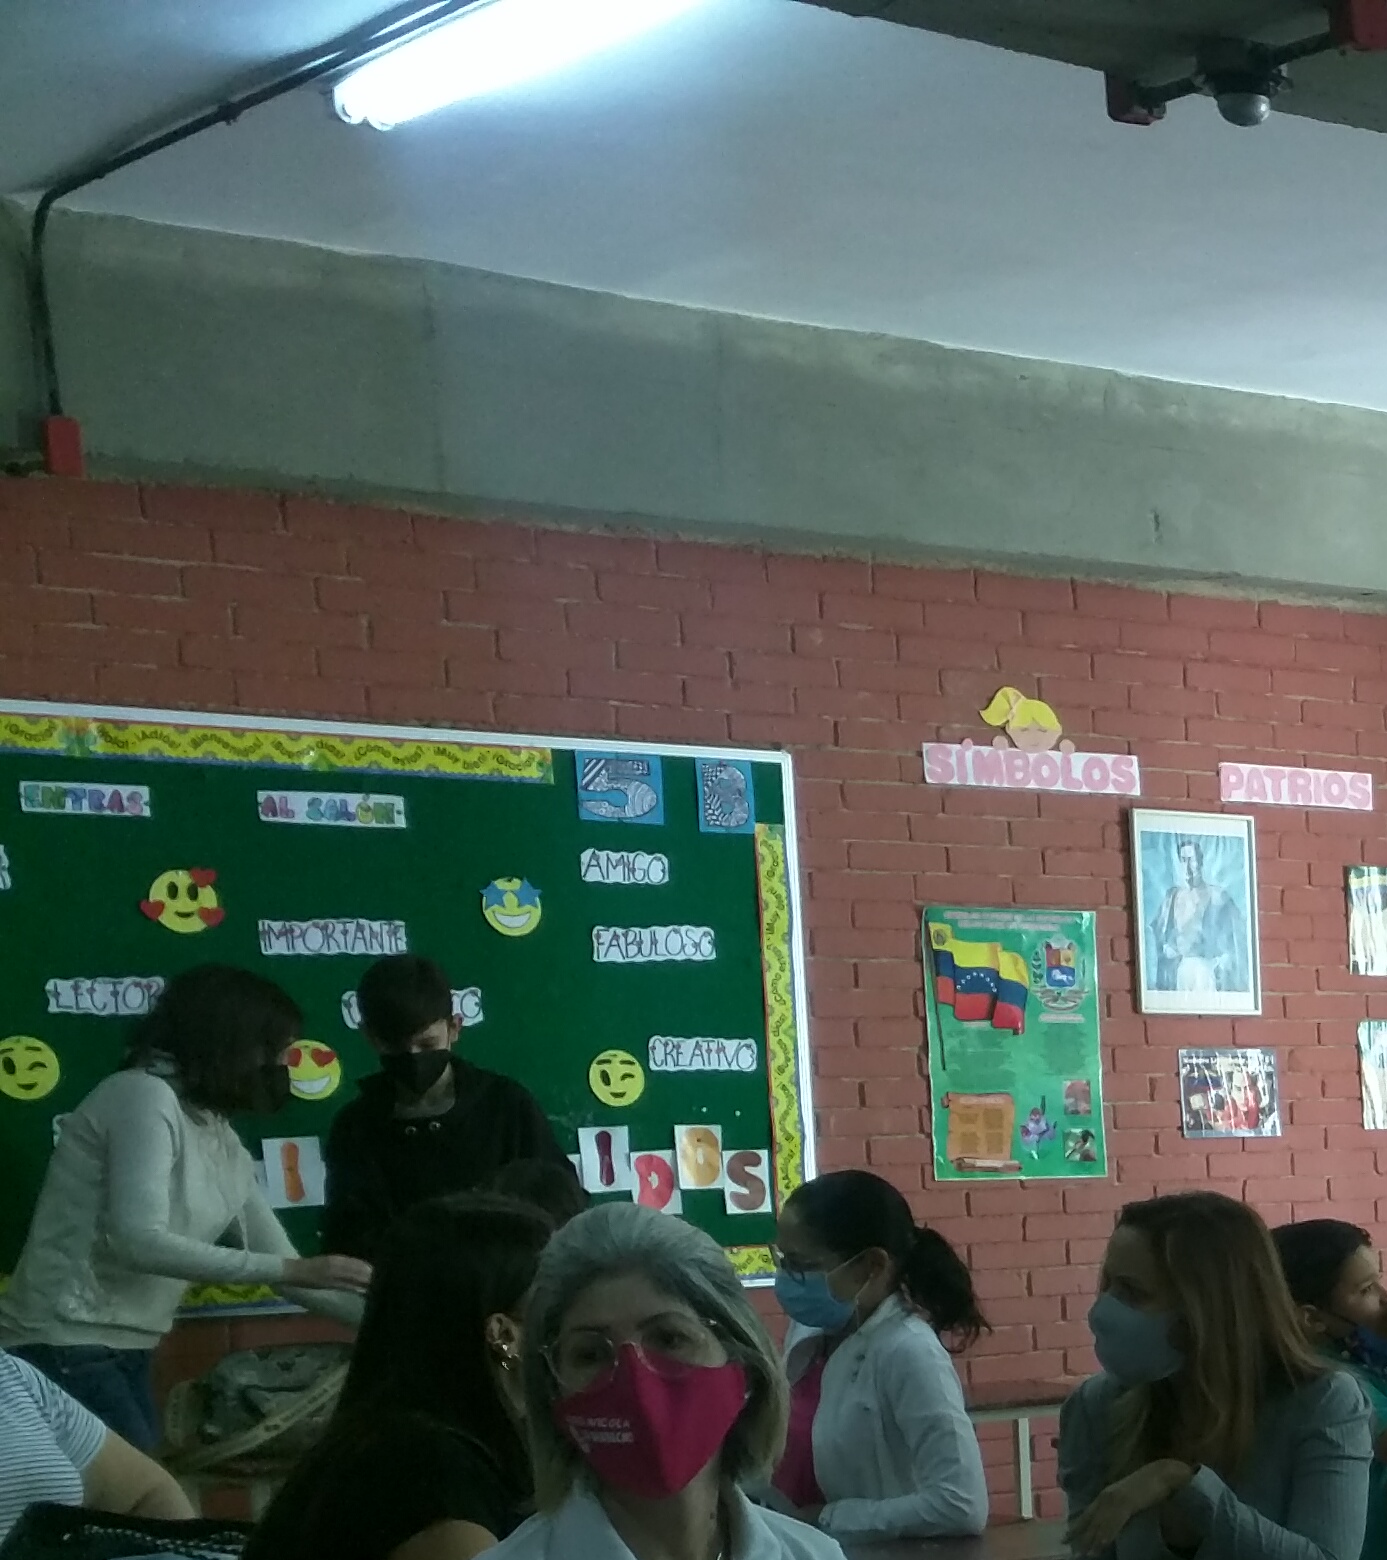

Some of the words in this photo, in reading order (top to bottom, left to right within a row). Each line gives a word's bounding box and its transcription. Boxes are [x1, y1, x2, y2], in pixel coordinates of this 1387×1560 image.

[23, 783, 144, 816] ENTRAS
[261, 794, 295, 819] AL
[581, 757, 658, 818] 5
[701, 762, 750, 828] B
[1221, 764, 1371, 808] PATRIOS
[583, 851, 667, 884] AMIGO
[260, 921, 405, 954] IMPORTANTE
[594, 927, 716, 959] FABULOSO
[651, 1037, 757, 1070] CREATIVO
